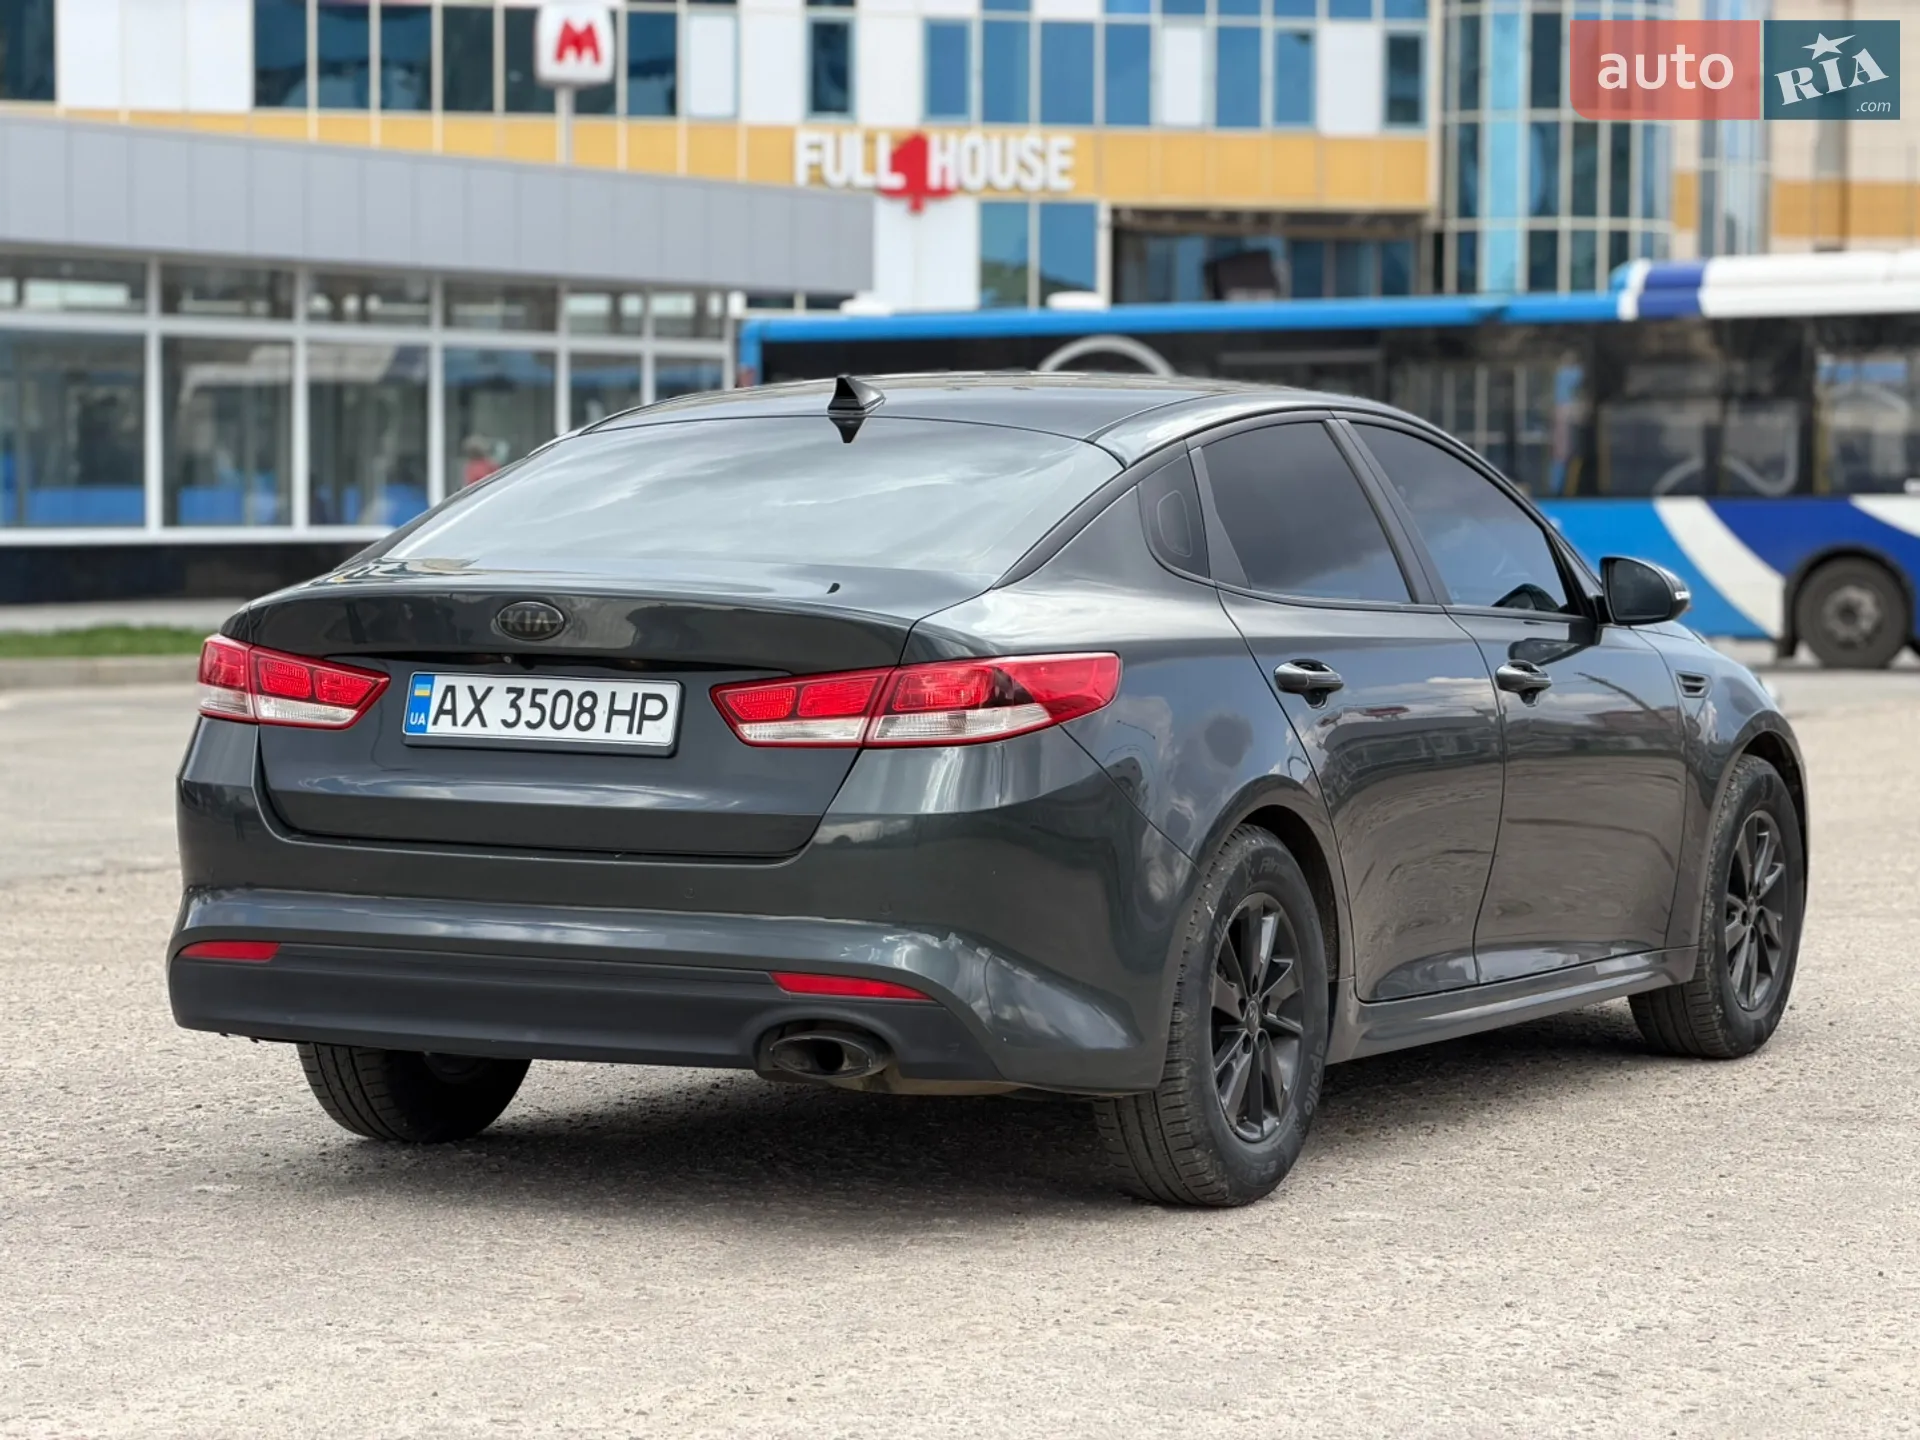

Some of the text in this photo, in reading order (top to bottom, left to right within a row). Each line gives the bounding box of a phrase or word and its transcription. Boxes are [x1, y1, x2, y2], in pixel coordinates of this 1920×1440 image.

[556, 19, 602, 65] M
[795, 132, 1076, 192] FULL HOUSE
[506, 610, 552, 631] KIA
[410, 713, 427, 726] UA
[432, 684, 669, 735] AX 3508 HP
[1304, 1039, 1325, 1117] apollo
